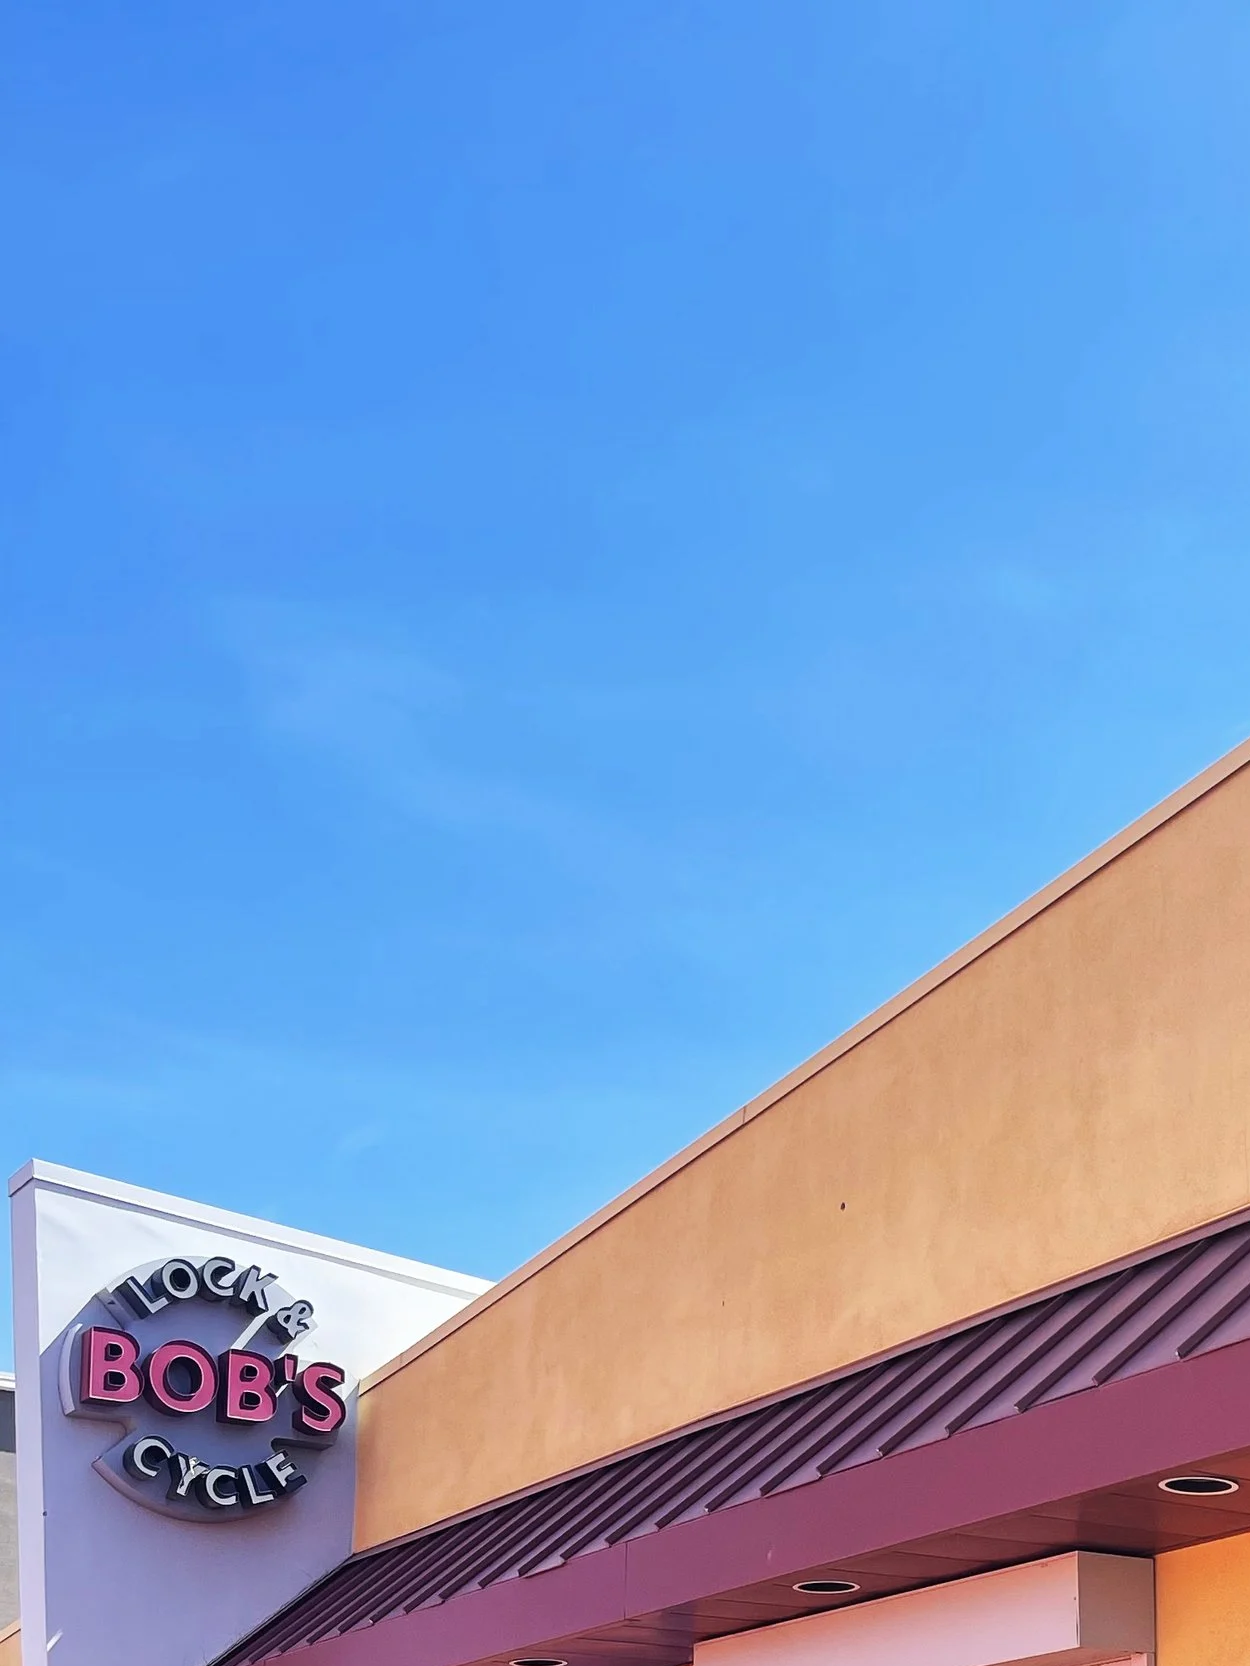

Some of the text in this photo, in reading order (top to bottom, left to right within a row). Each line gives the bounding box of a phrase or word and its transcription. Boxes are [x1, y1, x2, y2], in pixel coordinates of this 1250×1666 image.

[125, 1256, 314, 1344] LOCK &
[80, 1326, 346, 1436] BOB'S
[123, 1435, 308, 1507] CYCLE
